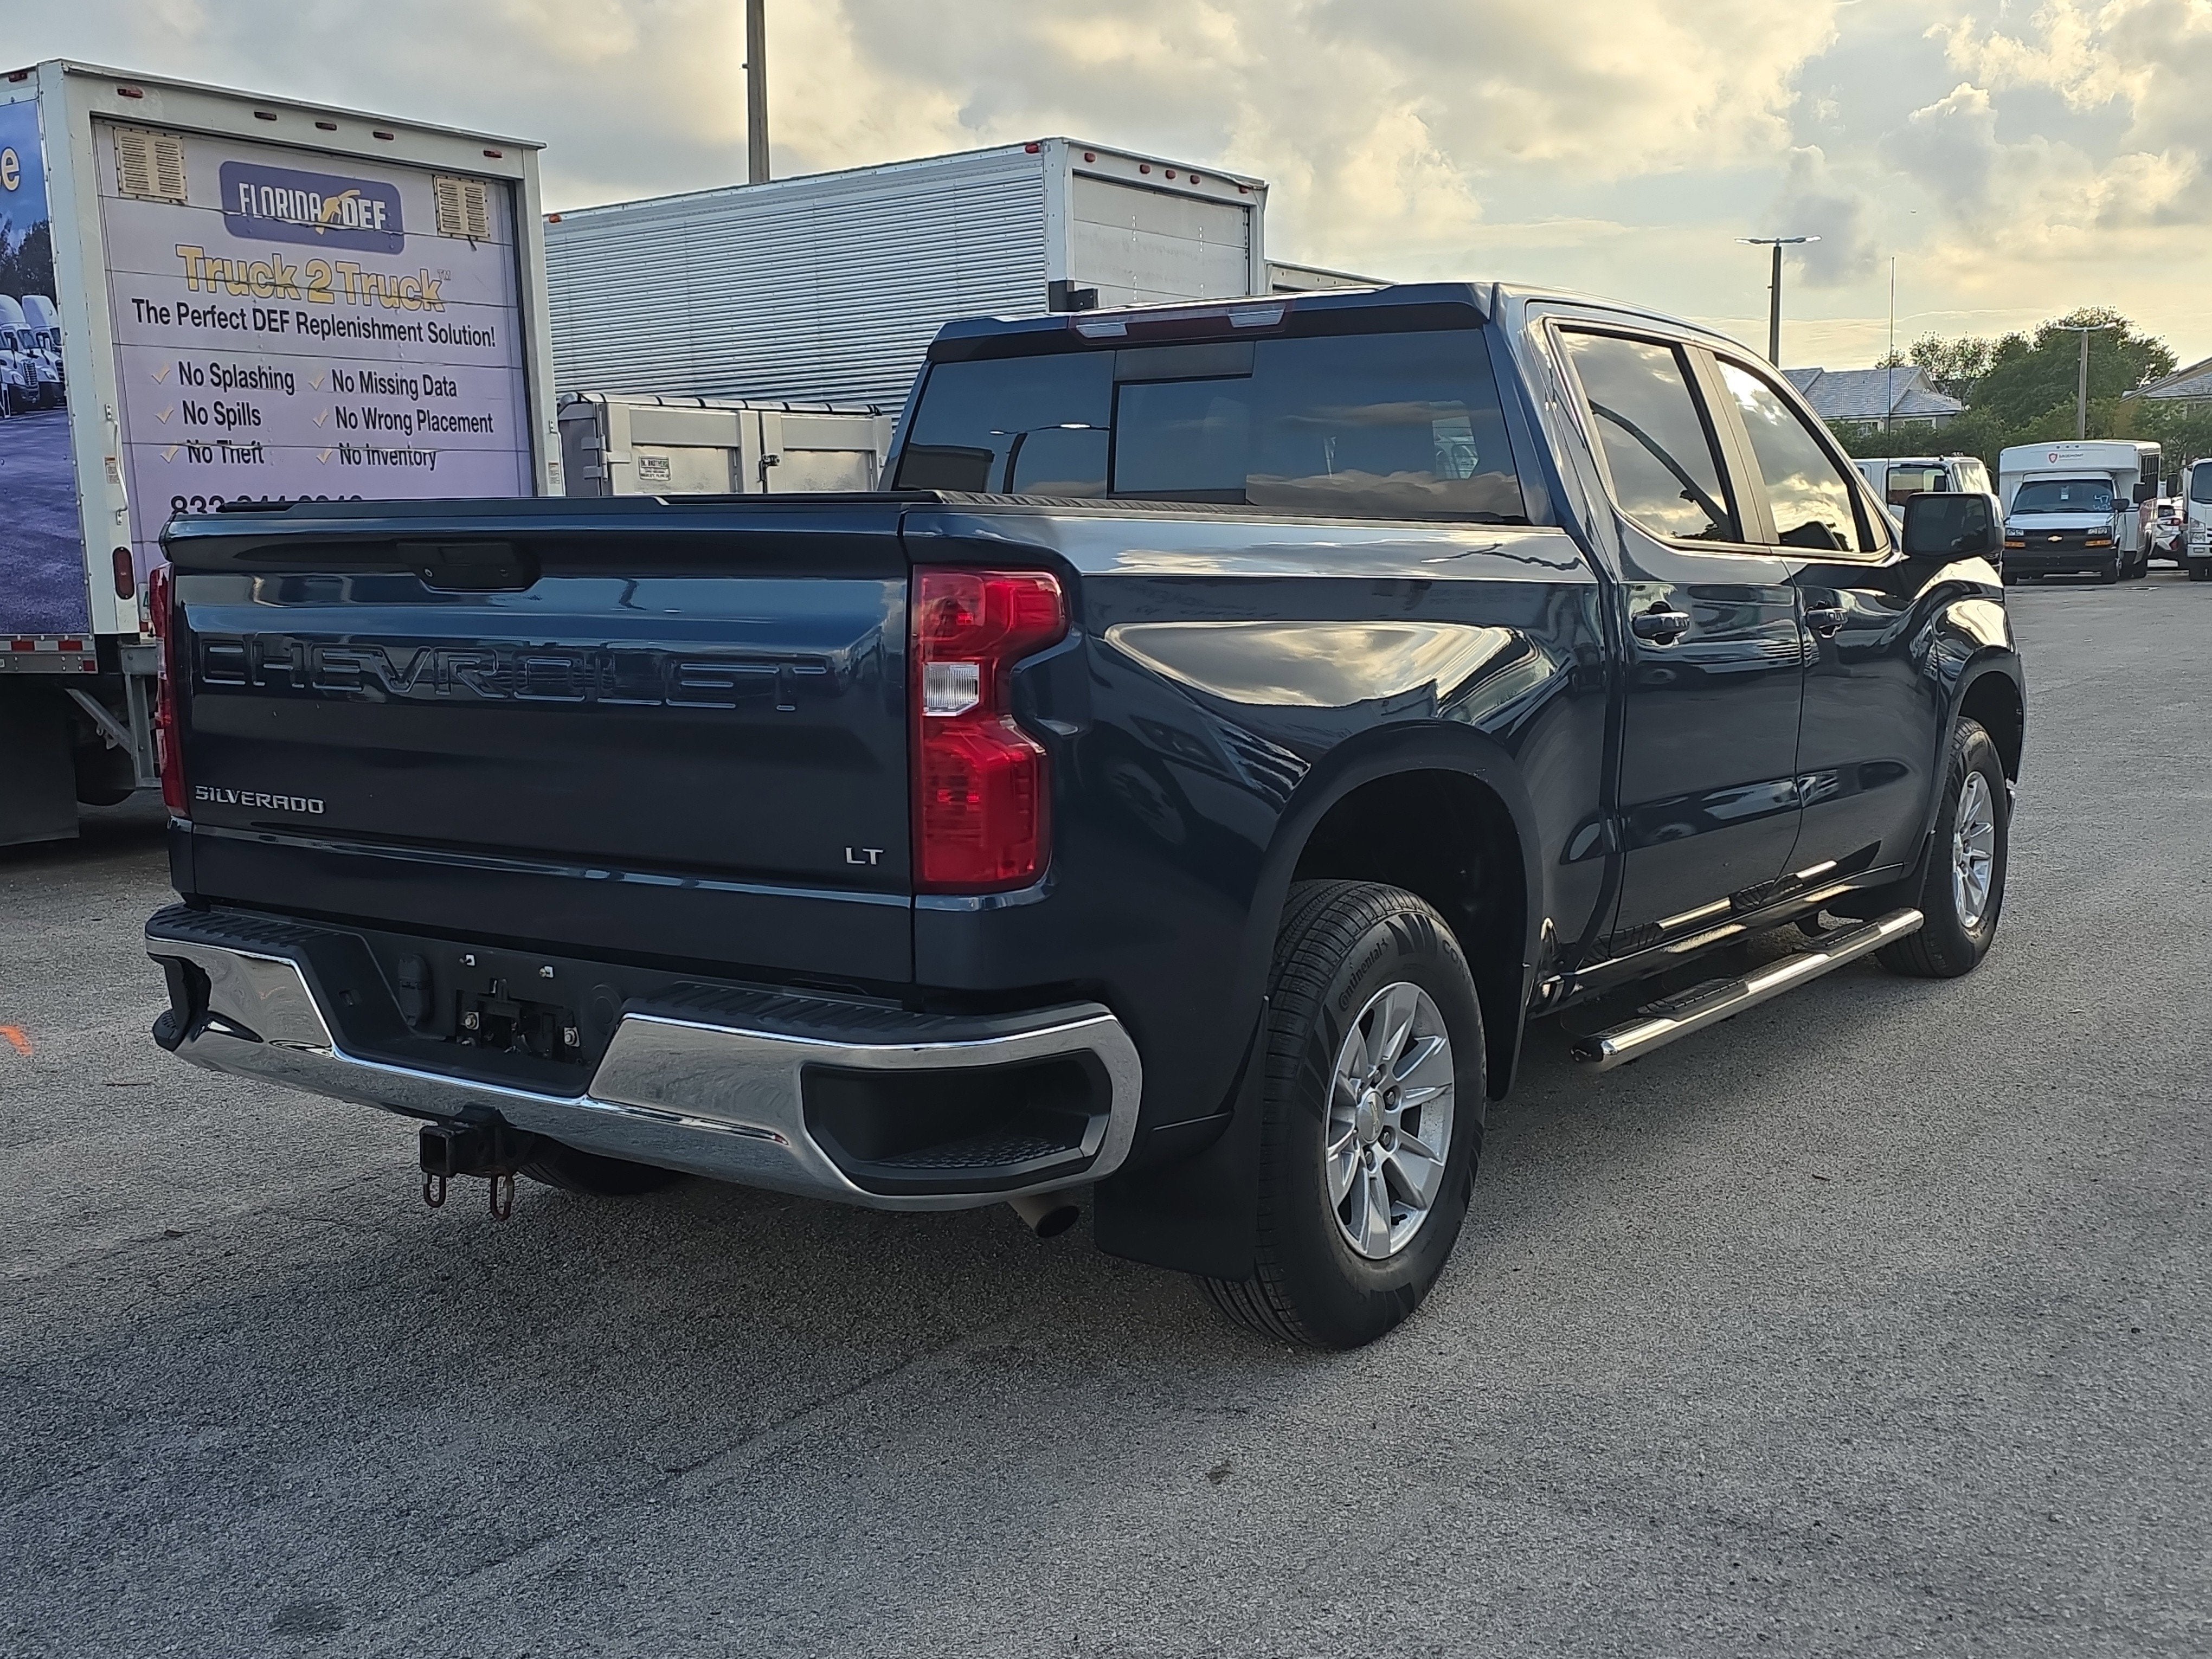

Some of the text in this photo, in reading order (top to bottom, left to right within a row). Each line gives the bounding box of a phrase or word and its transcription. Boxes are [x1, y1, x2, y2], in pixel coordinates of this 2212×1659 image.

[0, 146, 21, 191] e
[239, 183, 387, 229] FLORIDA DEF
[175, 243, 302, 300] Truck
[305, 259, 335, 304] 2
[335, 261, 446, 312] Truck
[131, 298, 496, 347] The Perfect DEF Replenishment Solution!
[178, 361, 295, 396] No Splashing
[331, 369, 458, 401] No Missing Data
[182, 400, 261, 431] No Spills
[335, 406, 494, 436] No Wrong Placement
[187, 439, 265, 464] No Theft
[338, 442, 437, 472] No Inventory
[200, 639, 828, 712] CHEVROLET
[195, 785, 325, 814] SILVERADO
[846, 847, 884, 865] LT
